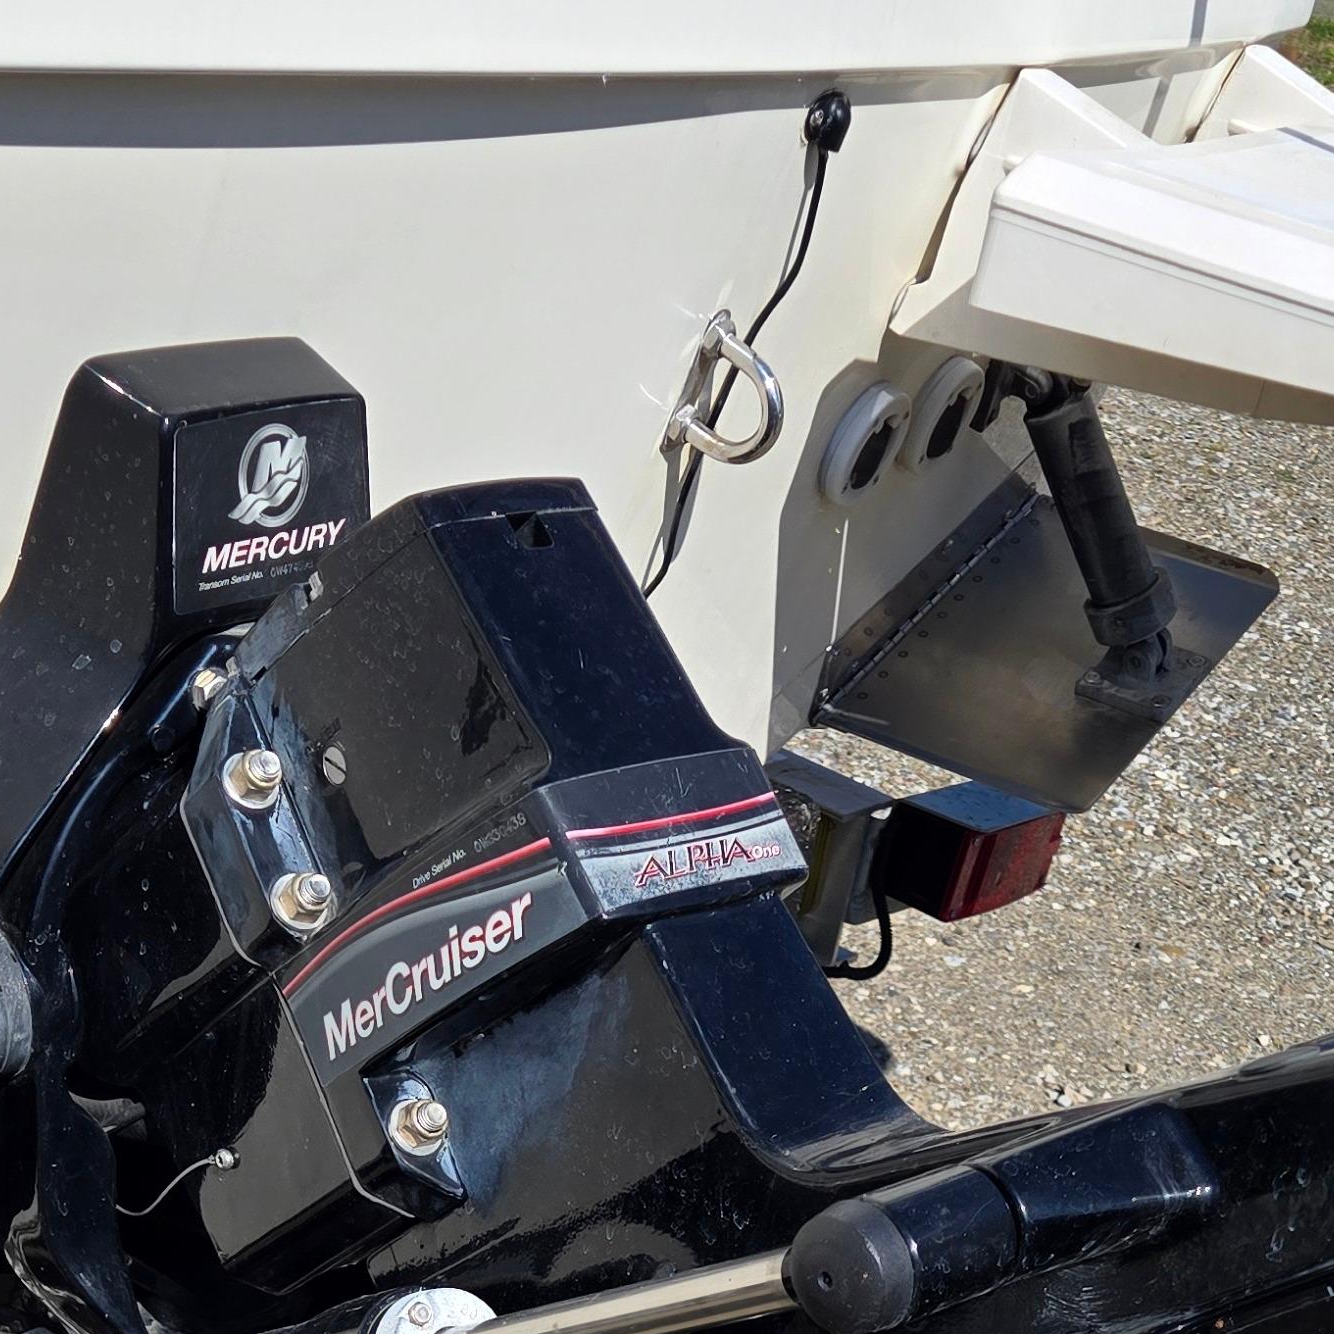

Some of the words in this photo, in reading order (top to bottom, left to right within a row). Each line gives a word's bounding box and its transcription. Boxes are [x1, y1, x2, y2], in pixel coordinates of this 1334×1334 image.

[201, 517, 347, 574] MERCURY
[198, 579, 230, 592] Transom
[230, 572, 252, 585] Serial
[412, 870, 431, 889] Drive
[431, 855, 453, 876] Serial
[452, 848, 467, 863] No.
[635, 836, 754, 887] ALPHA
[750, 842, 782, 861] One
[322, 891, 533, 1062] MerCruiser
